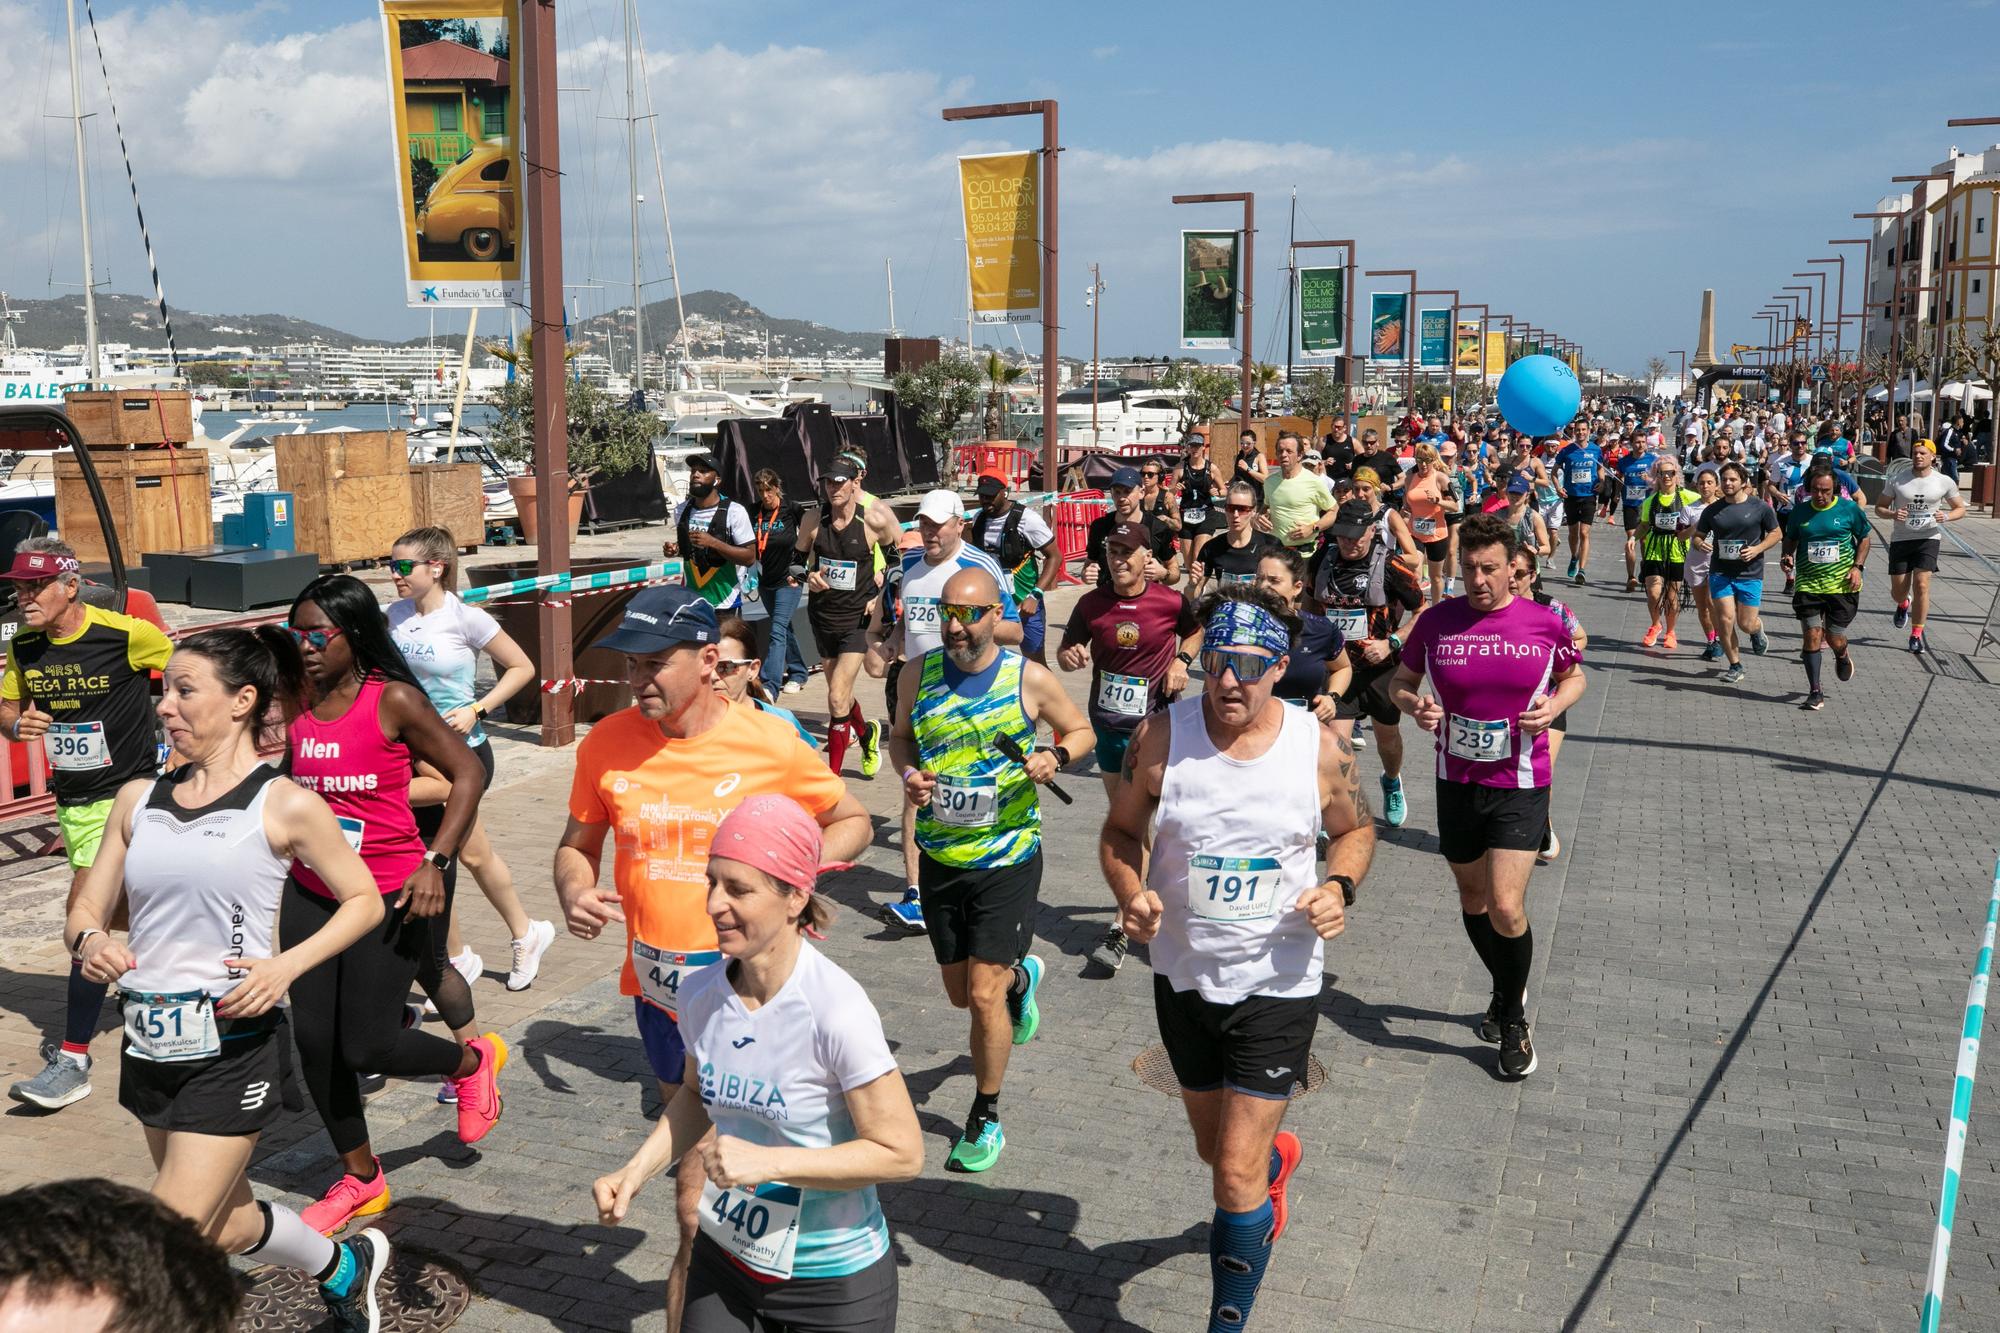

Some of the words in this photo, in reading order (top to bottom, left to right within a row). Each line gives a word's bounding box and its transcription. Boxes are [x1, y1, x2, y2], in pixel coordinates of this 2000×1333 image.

[968, 177, 1032, 195] COLORS
[969, 194, 998, 210] DEL
[1001, 192, 1035, 208] MON
[973, 221, 1028, 234] 29.04.2023
[442, 287, 480, 298] Fundació
[1304, 289, 1320, 297] DEL
[1321, 288, 1341, 297] MO
[983, 313, 1031, 322] CaixaForum
[1813, 547, 1832, 557] 461
[825, 568, 846, 580] 464
[909, 606, 936, 622] 526
[1438, 633, 1501, 642] bournemouth
[67, 675, 110, 690] RACE
[1104, 684, 1135, 703] 410
[53, 736, 89, 755] 396
[1456, 729, 1494, 749] 239
[300, 738, 340, 759] Nen
[323, 774, 378, 792] RUNS
[940, 788, 979, 811] 301
[1206, 875, 1260, 902] 191
[1229, 903, 1250, 912] David
[134, 1007, 183, 1039] 451
[719, 1072, 787, 1108] IBIZA
[718, 1098, 789, 1121] MARATHON
[712, 1190, 770, 1240] 440
[732, 1234, 776, 1260] AnnaBathy
